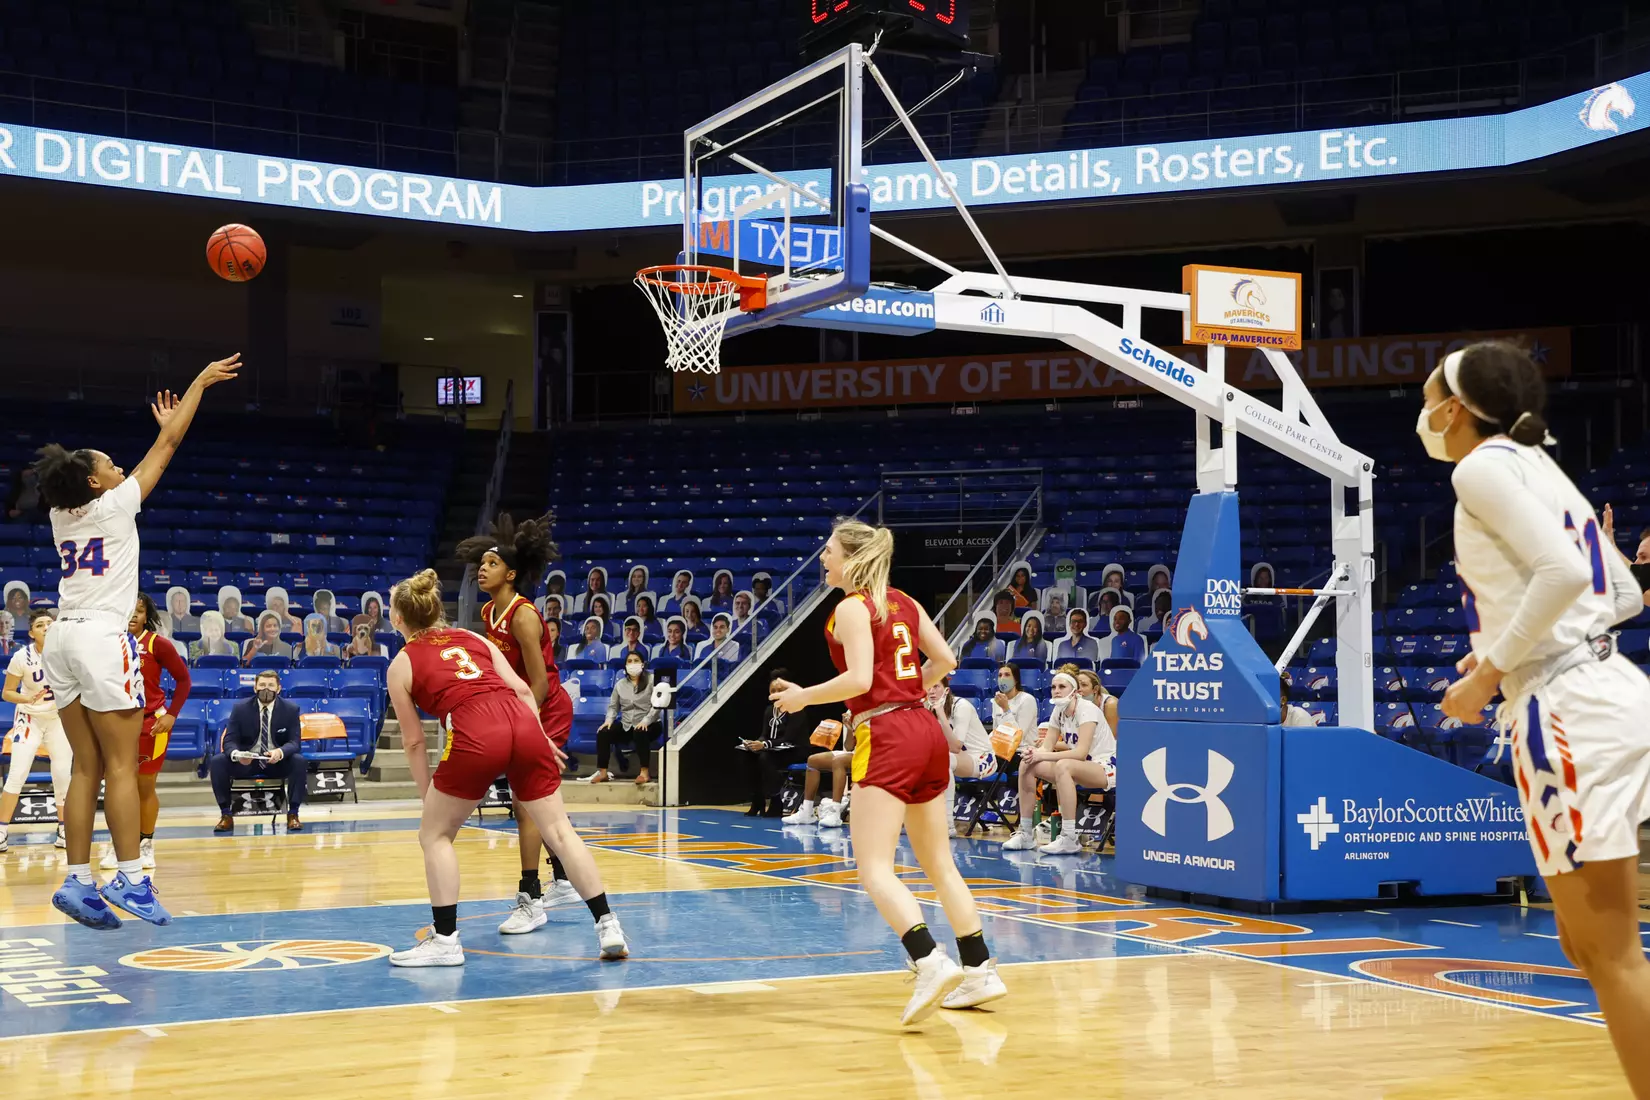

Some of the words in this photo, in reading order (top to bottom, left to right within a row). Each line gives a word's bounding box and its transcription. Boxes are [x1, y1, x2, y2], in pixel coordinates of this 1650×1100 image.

[35, 131, 242, 195] DIGITAL
[257, 159, 502, 223] PROGRAM
[861, 168, 958, 204] ame
[970, 149, 1121, 197] Details,
[1135, 143, 1304, 185] Rosters,
[1319, 131, 1398, 171] Etc.
[1223, 309, 1271, 323] MAVERICKS
[1238, 318, 1264, 327] ARLINGTON
[1210, 333, 1228, 342] UTA
[1231, 335, 1284, 345] MAVERICKS
[1118, 337, 1196, 388] Schelde
[714, 363, 945, 405] UNIVERSITY
[959, 360, 1012, 394] OF
[1025, 357, 1146, 390] TEXA
[1244, 404, 1283, 431] COLLEGE
[1285, 425, 1309, 444] PARK
[1309, 438, 1344, 462] CENTER
[924, 538, 964, 547] ELEVATOR
[966, 537, 995, 546] ACCESS
[60, 537, 110, 579] 34
[1206, 578, 1241, 594] DON
[1204, 593, 1242, 609] DAVIS
[892, 622, 919, 680] 2
[1152, 650, 1224, 673] TEXAS
[440, 646, 484, 681] 3
[1152, 678, 1223, 700] TRUST
[1342, 797, 1524, 831] BaylorScott&White
[1344, 832, 1417, 844] ORTHOPEDIC
[1419, 832, 1442, 843] AND
[1445, 831, 1478, 843] SPINE
[1480, 831, 1530, 843] HOSPITAL
[1142, 849, 1181, 865] UNDER
[1183, 854, 1236, 872] ARMOUR
[1344, 852, 1390, 861] ARLINGTON
